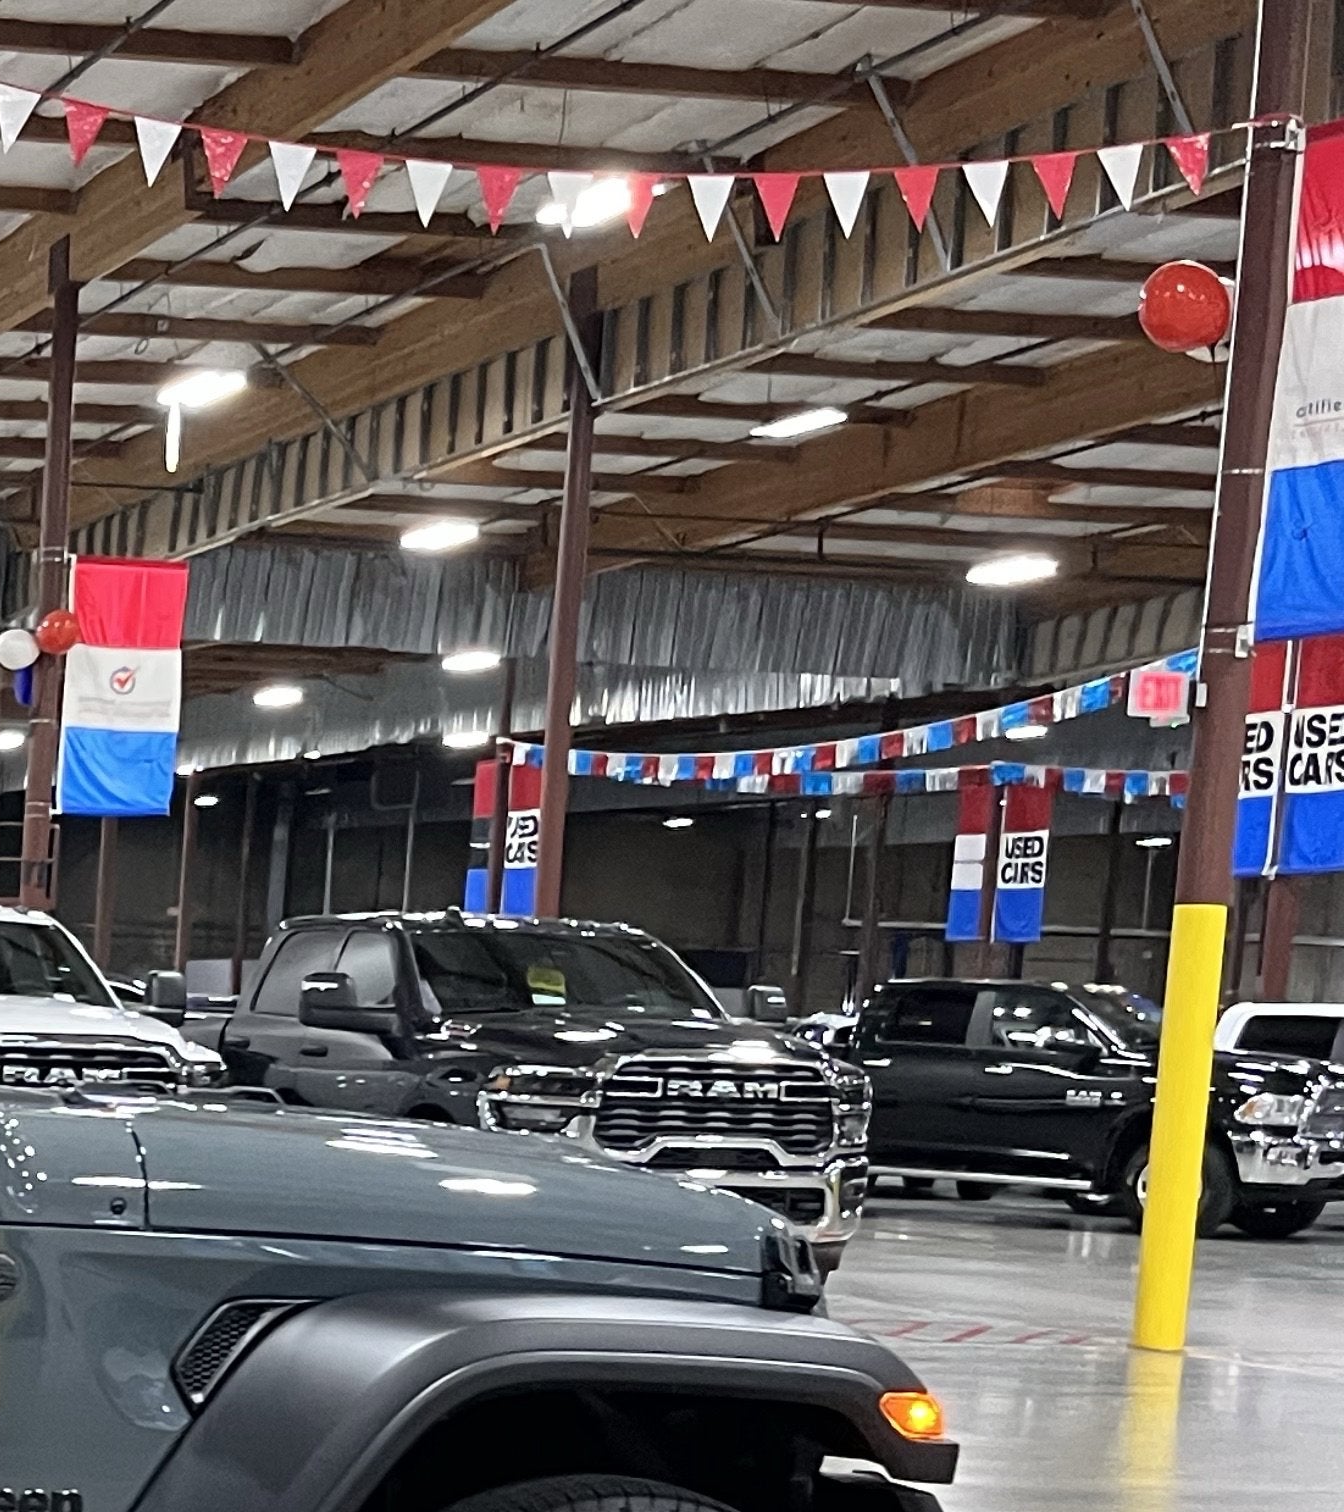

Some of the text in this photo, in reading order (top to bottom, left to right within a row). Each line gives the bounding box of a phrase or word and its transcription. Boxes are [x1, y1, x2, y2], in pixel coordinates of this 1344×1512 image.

[1245, 721, 1274, 755] ED
[1294, 714, 1344, 748] USE
[1243, 757, 1274, 791] RS
[1005, 836, 1044, 859] USED
[667, 1080, 778, 1098] RAM
